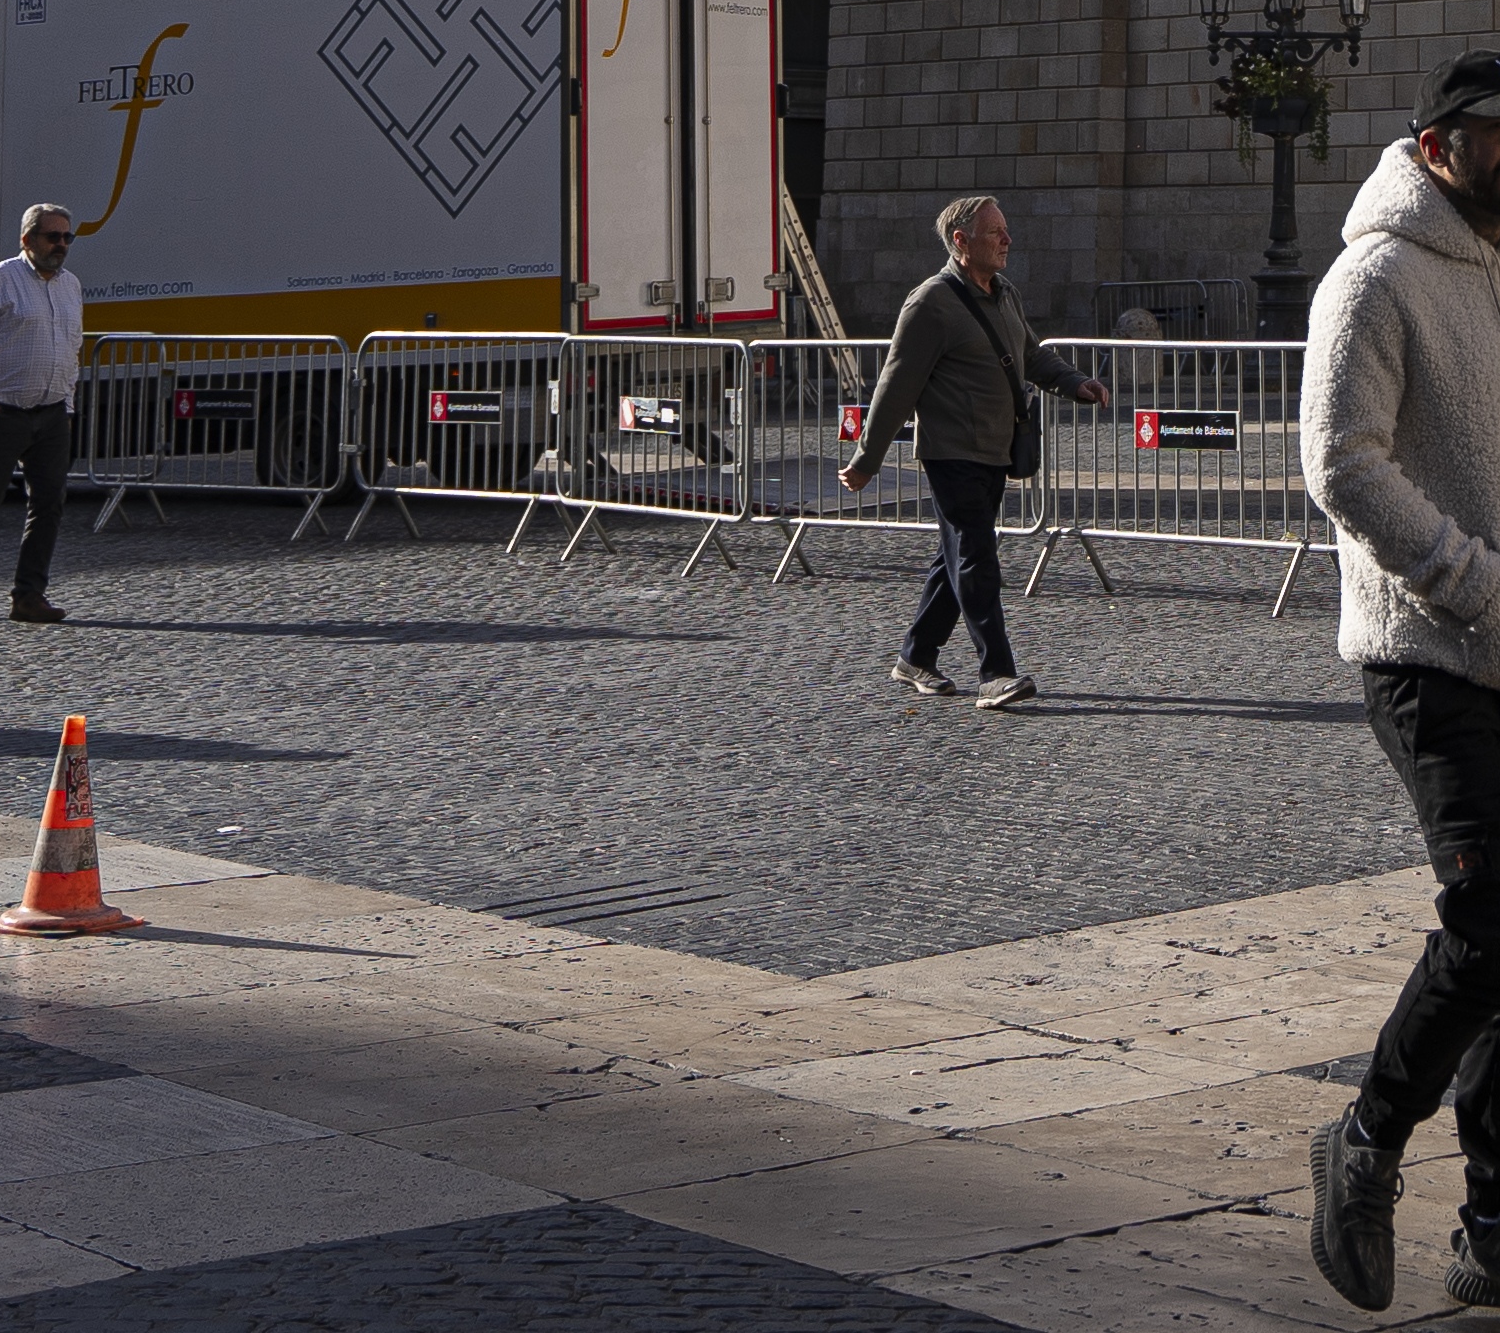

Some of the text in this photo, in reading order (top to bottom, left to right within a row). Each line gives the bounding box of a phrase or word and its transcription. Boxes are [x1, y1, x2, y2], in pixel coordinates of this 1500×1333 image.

[77, 63, 195, 104] FELTRERO
[287, 275, 343, 288] Salamanca
[350, 271, 385, 284] Madrid
[393, 268, 444, 282] Barcelona
[451, 266, 499, 279] Zaragoza
[507, 262, 554, 275] Granada
[82, 281, 194, 299] ww.feltrero.com
